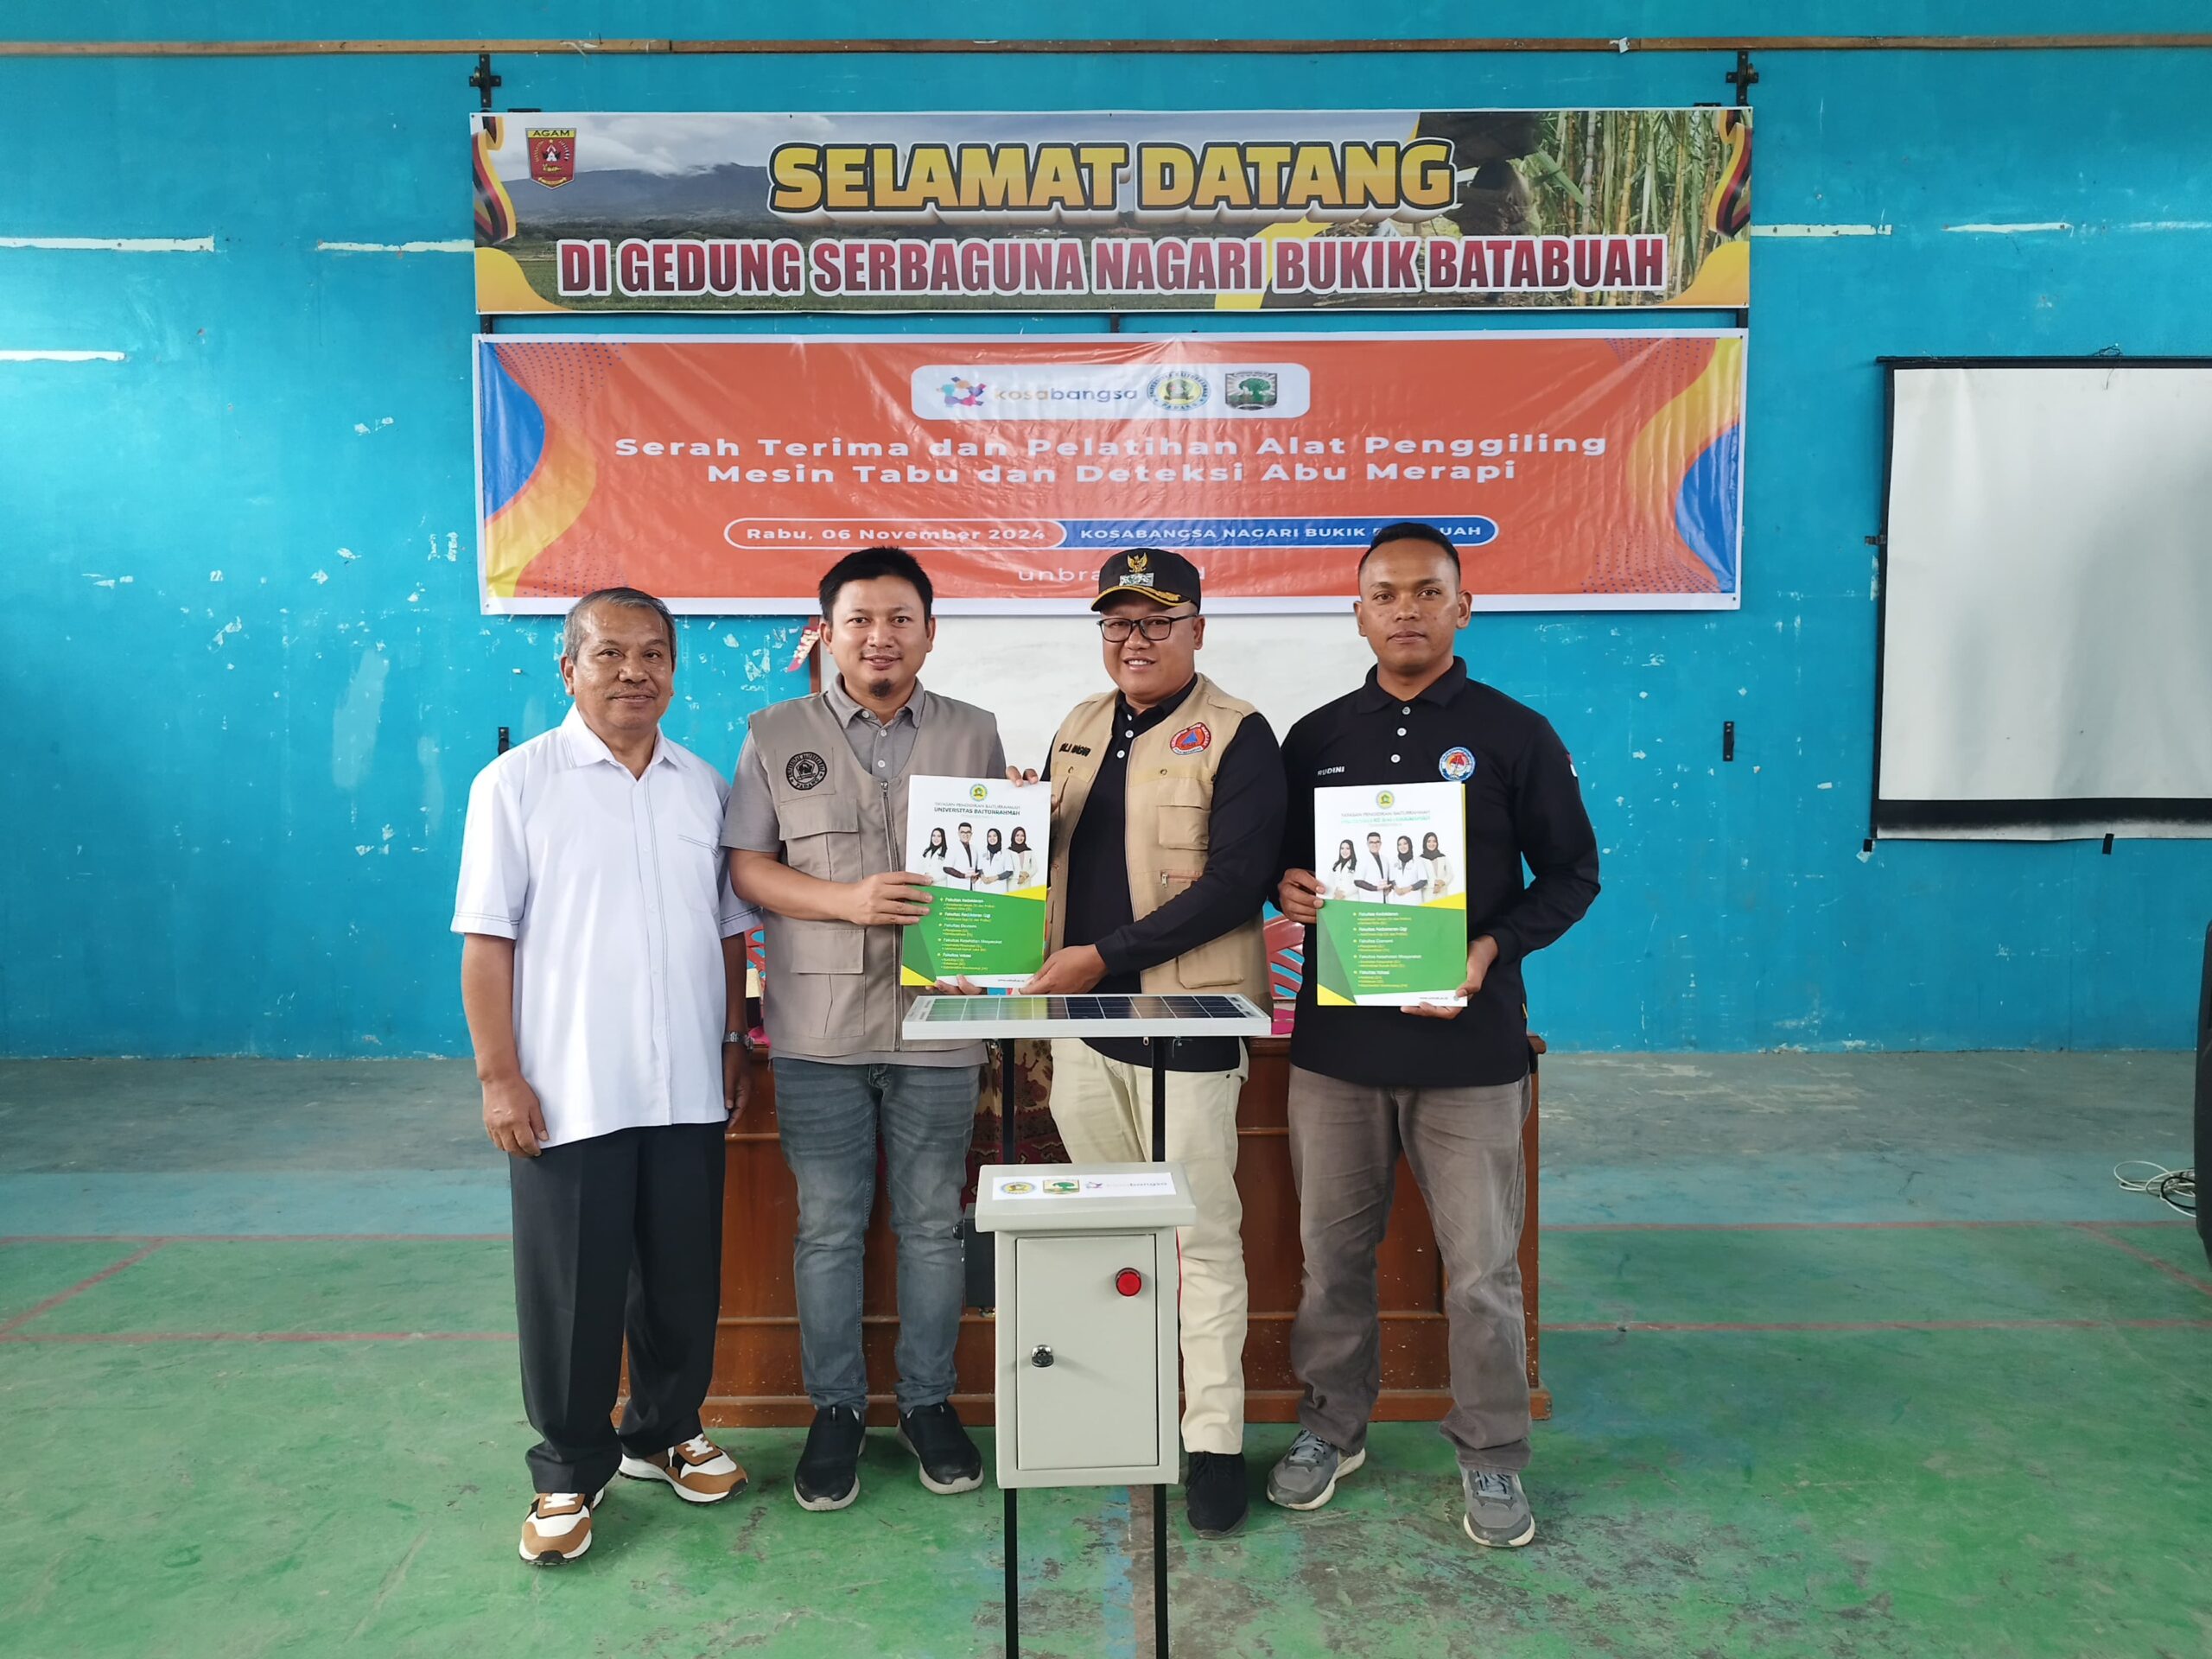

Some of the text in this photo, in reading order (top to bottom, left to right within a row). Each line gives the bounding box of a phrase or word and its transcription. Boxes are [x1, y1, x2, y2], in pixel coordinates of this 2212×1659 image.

[769, 139, 1457, 213] SELAMAT DATANG
[558, 238, 1665, 294] DI GEDUNG SERBAGUNA NAGARI BUKIK BATABUAH
[994, 387, 1138, 403] kosabangsa
[614, 433, 1607, 458] Serah Terima dan Pelatihan Alat Penggiling
[707, 460, 1516, 484] Mesin Tabu dan Deteksi Abu Merapi
[747, 528, 1046, 541] Rabu, 06 November 2024
[1080, 529, 1217, 539] KOSABANGSA
[1223, 528, 1300, 538] NAGARI
[1306, 526, 1366, 537] BUKIK
[1317, 766, 1346, 777] RUDINI
